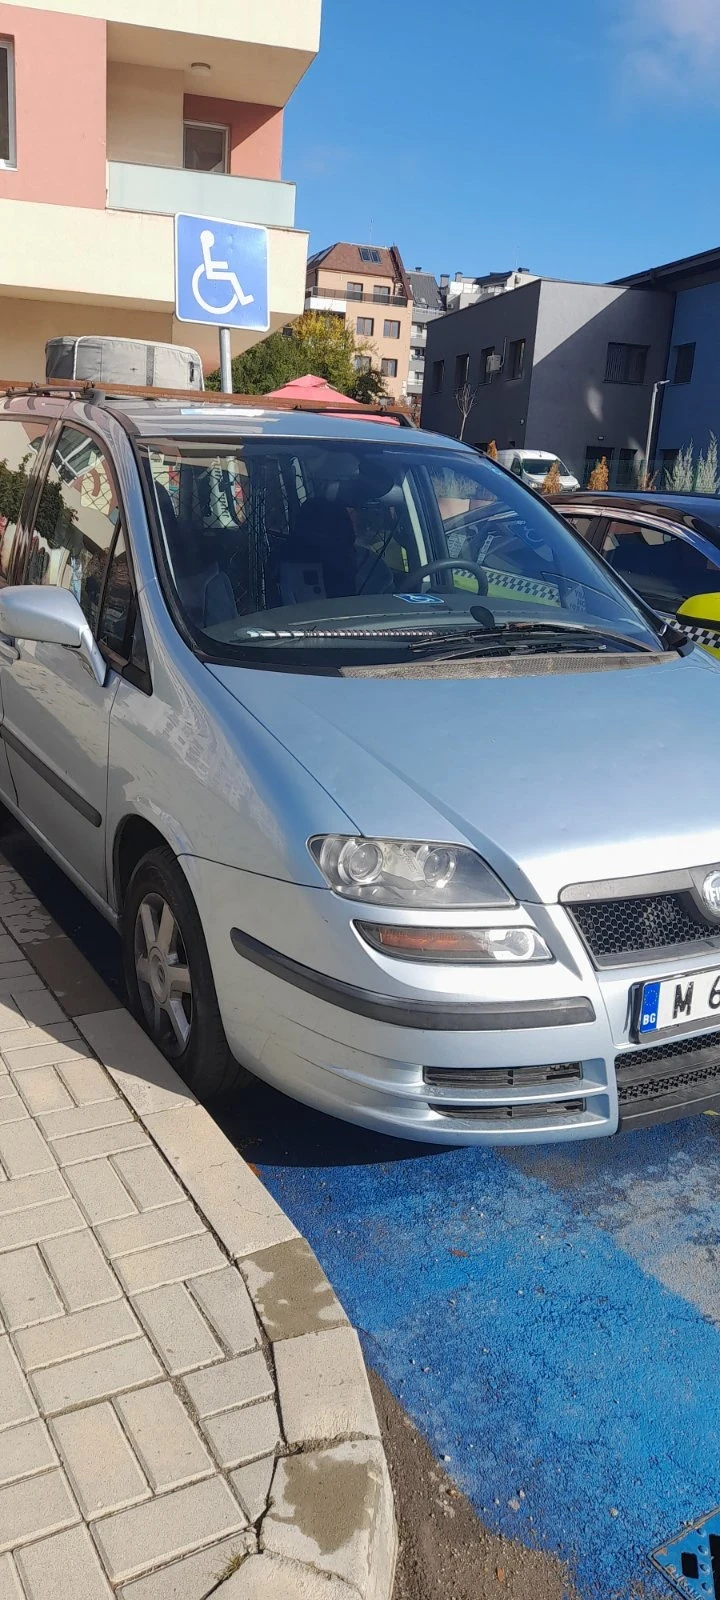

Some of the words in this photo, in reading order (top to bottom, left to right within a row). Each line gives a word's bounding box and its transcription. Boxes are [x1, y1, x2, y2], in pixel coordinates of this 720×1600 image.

[672, 981, 694, 1019] M
[708, 975, 720, 1010] 6
[643, 1013, 656, 1025] BG
